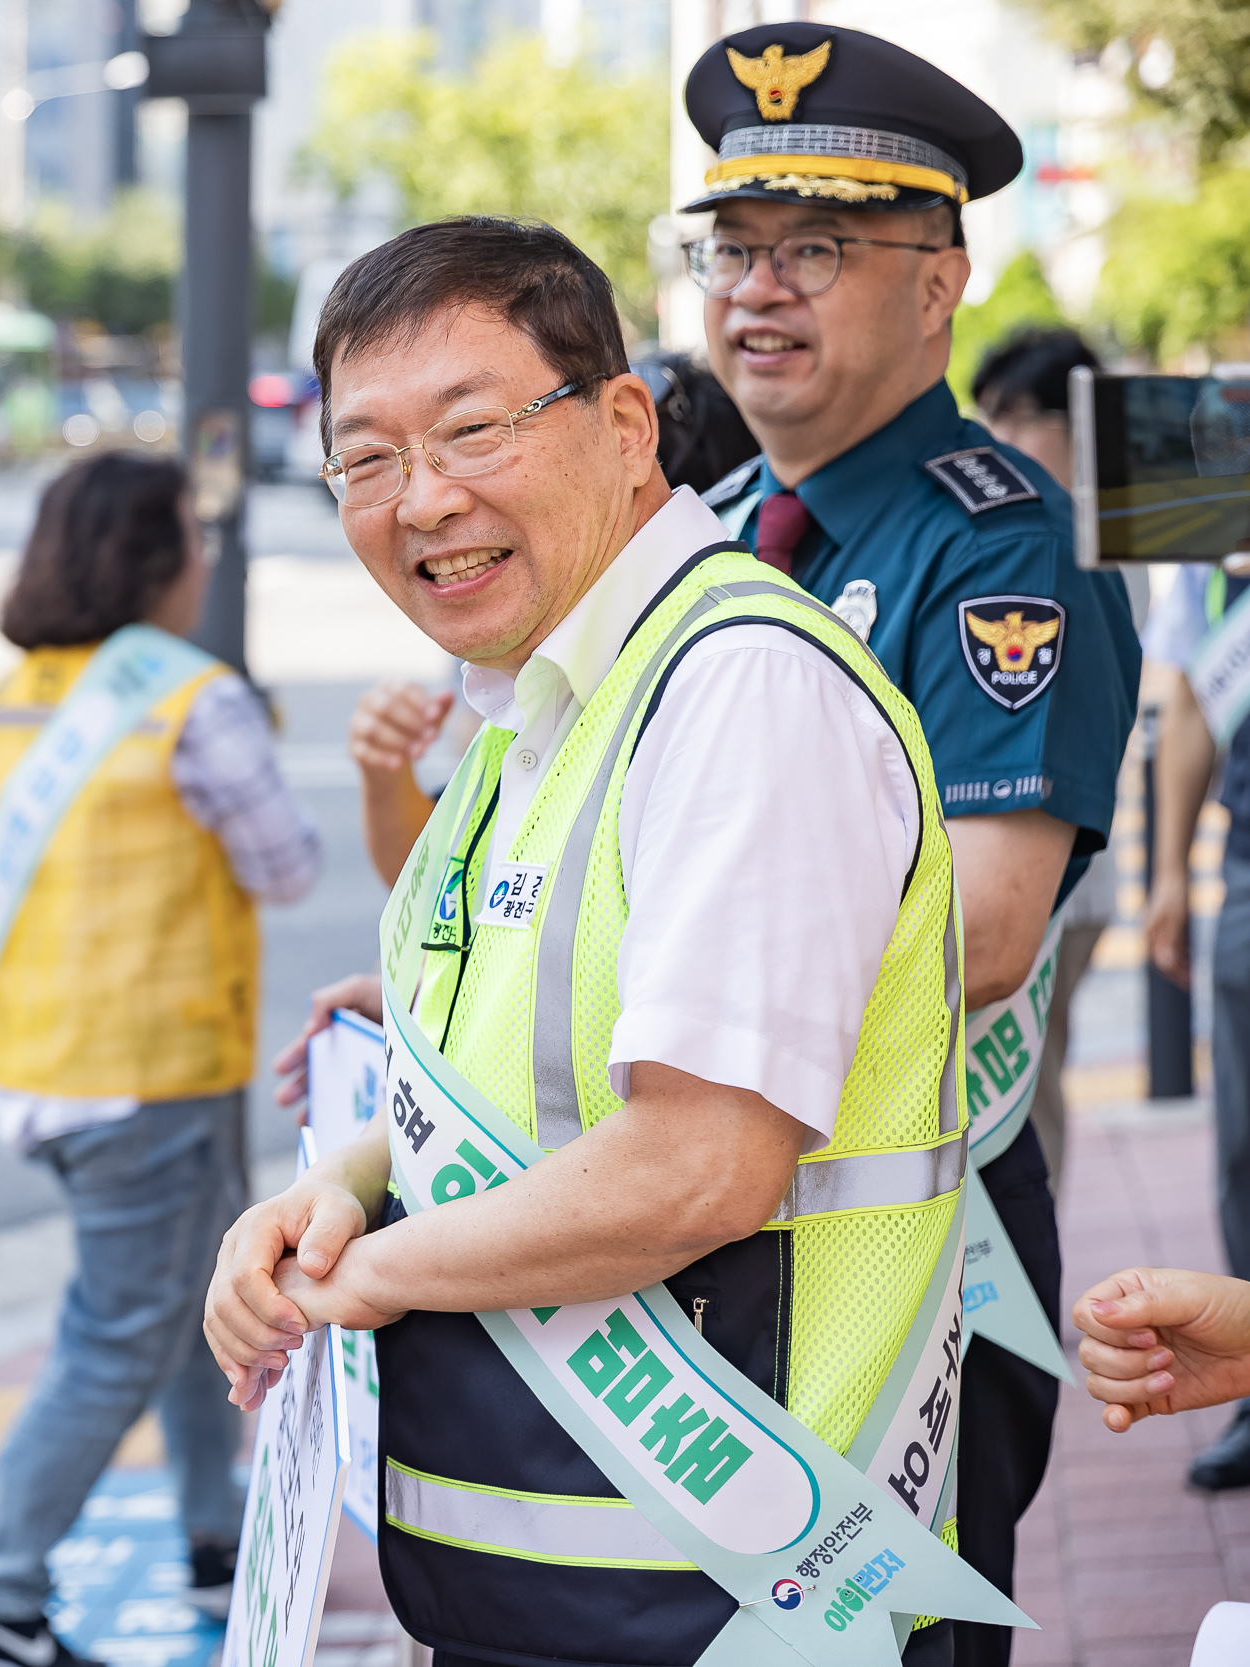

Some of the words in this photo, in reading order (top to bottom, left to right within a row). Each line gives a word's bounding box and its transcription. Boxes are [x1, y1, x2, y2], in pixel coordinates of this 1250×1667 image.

[991, 671, 1038, 686] POLICE
[511, 873, 528, 896] 김
[393, 1077, 436, 1155] 앞
[566, 1307, 754, 1505] 멈춤
[795, 1502, 873, 1578] 행정안전부
